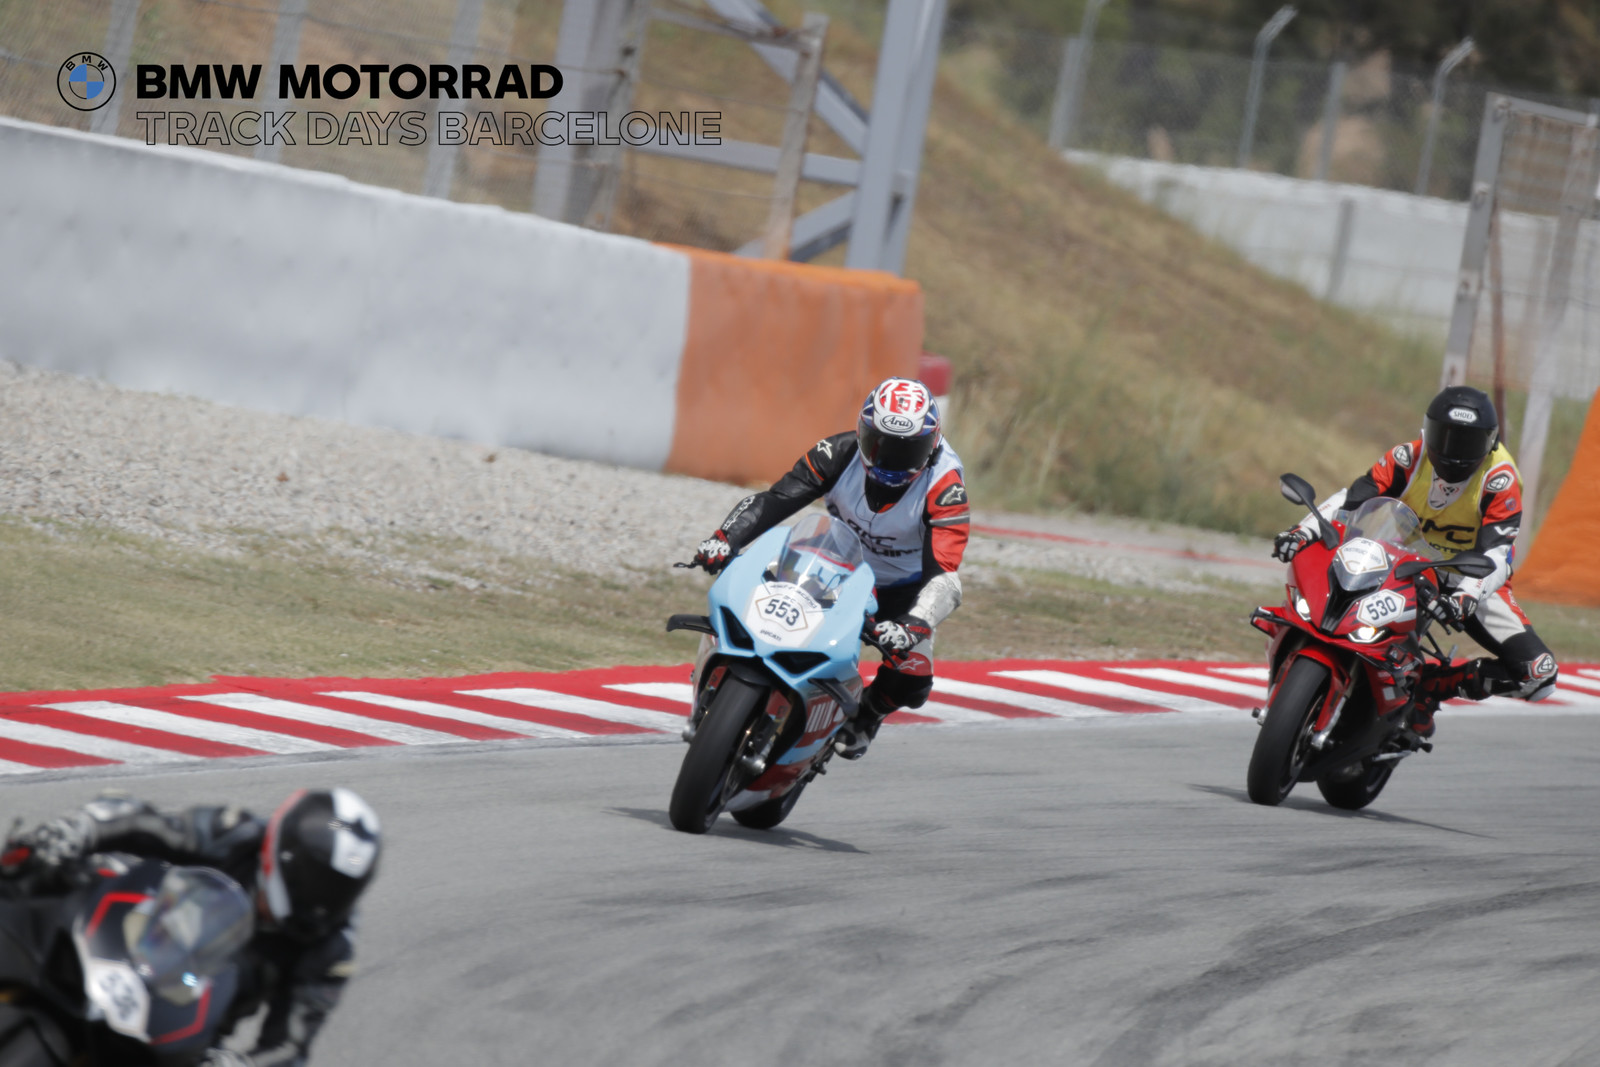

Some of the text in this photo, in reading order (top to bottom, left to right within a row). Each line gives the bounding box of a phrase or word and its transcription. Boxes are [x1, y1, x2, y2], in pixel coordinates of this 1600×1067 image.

[886, 416, 910, 427] Arai
[1453, 410, 1474, 420] SHOEI
[764, 598, 800, 627] 553
[1365, 596, 1398, 621] 530
